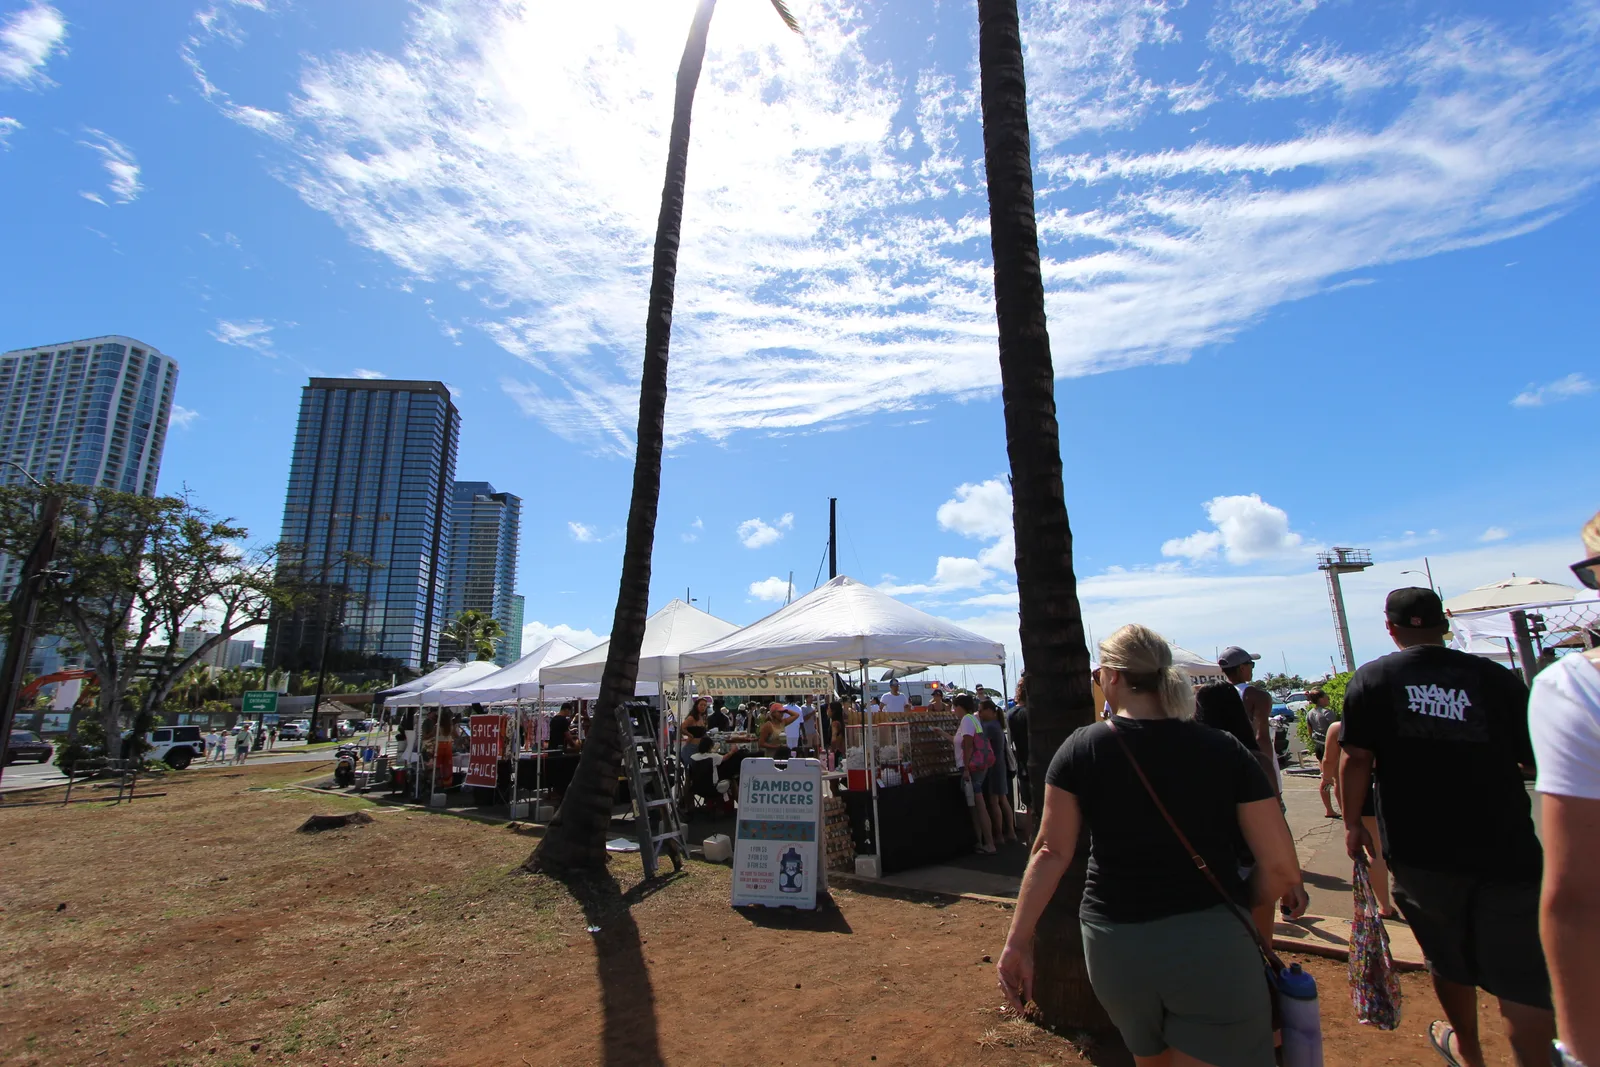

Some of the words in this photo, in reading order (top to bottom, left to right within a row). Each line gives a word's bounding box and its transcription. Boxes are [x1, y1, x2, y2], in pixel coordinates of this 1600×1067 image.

[706, 677, 769, 689] BAMBOO
[775, 677, 828, 688] STICKERS
[472, 743, 497, 756] NINJA
[467, 763, 495, 778] SAUCE
[752, 780, 813, 792] BAMBOO
[751, 793, 813, 805] STICKERS
